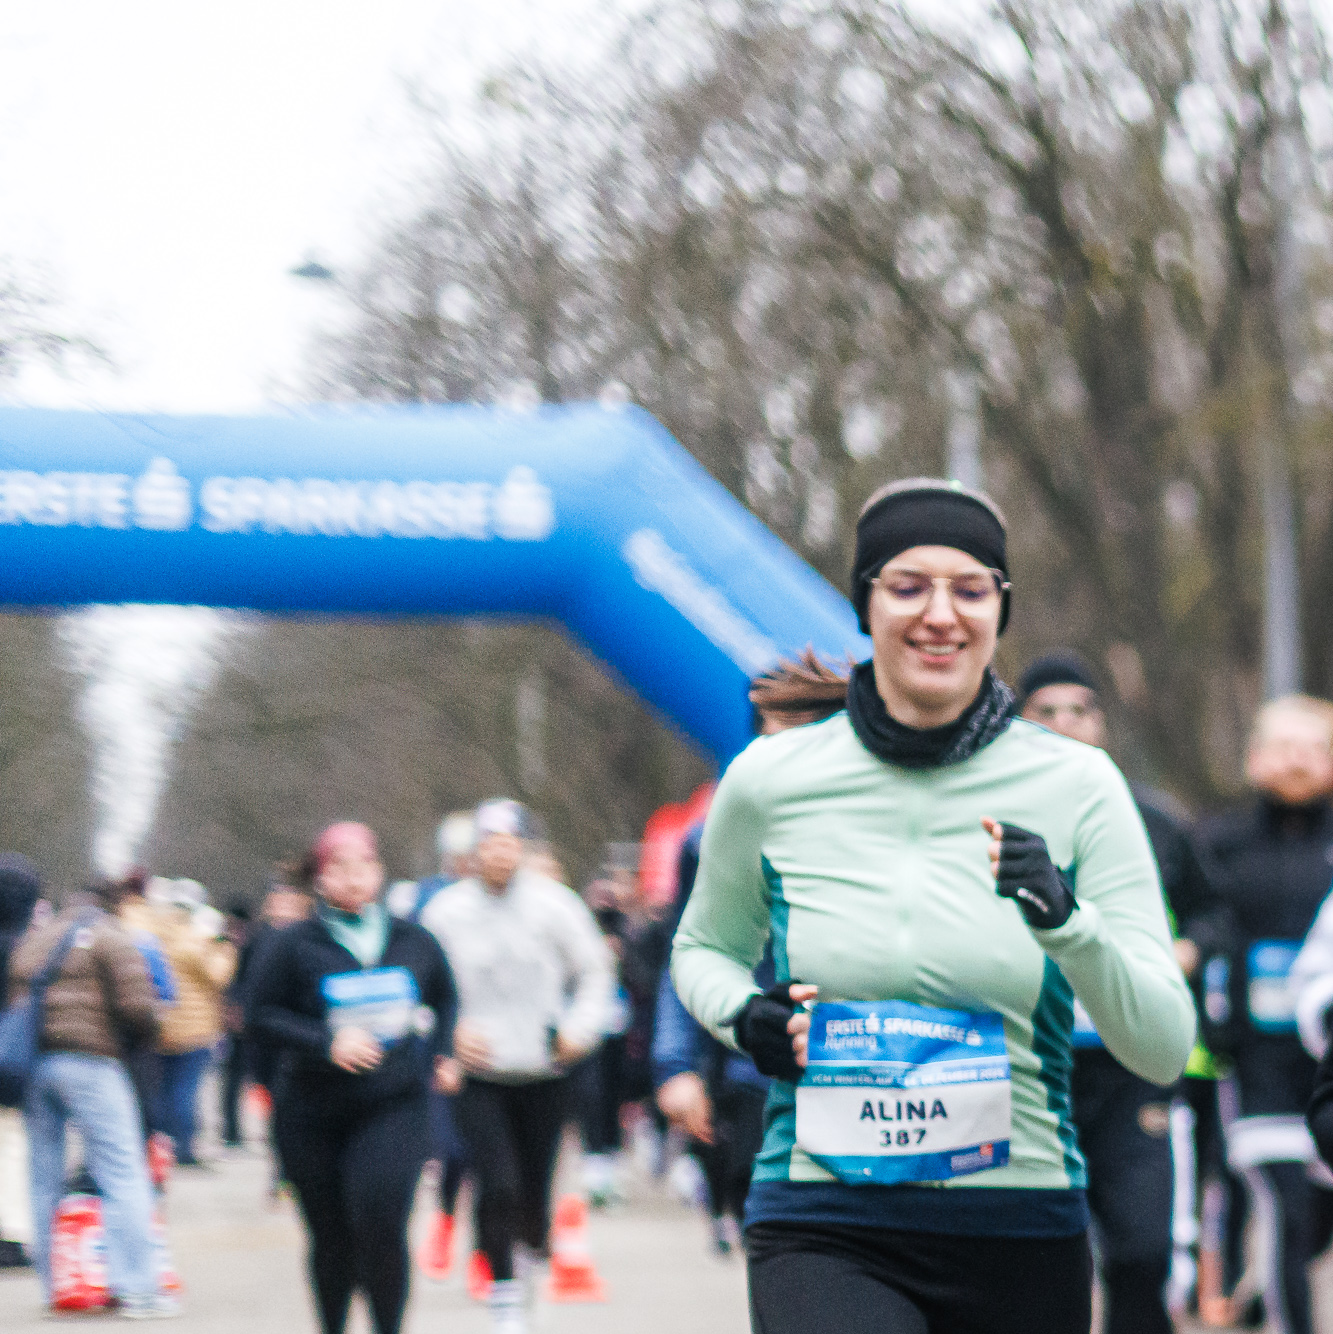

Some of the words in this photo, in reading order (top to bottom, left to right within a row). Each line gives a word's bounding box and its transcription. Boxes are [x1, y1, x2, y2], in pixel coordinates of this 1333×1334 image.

[826, 1018, 864, 1035] ERSTE
[883, 1017, 966, 1044] SPARKASSE
[860, 1098, 948, 1122] ALINA
[879, 1128, 927, 1148] 387
